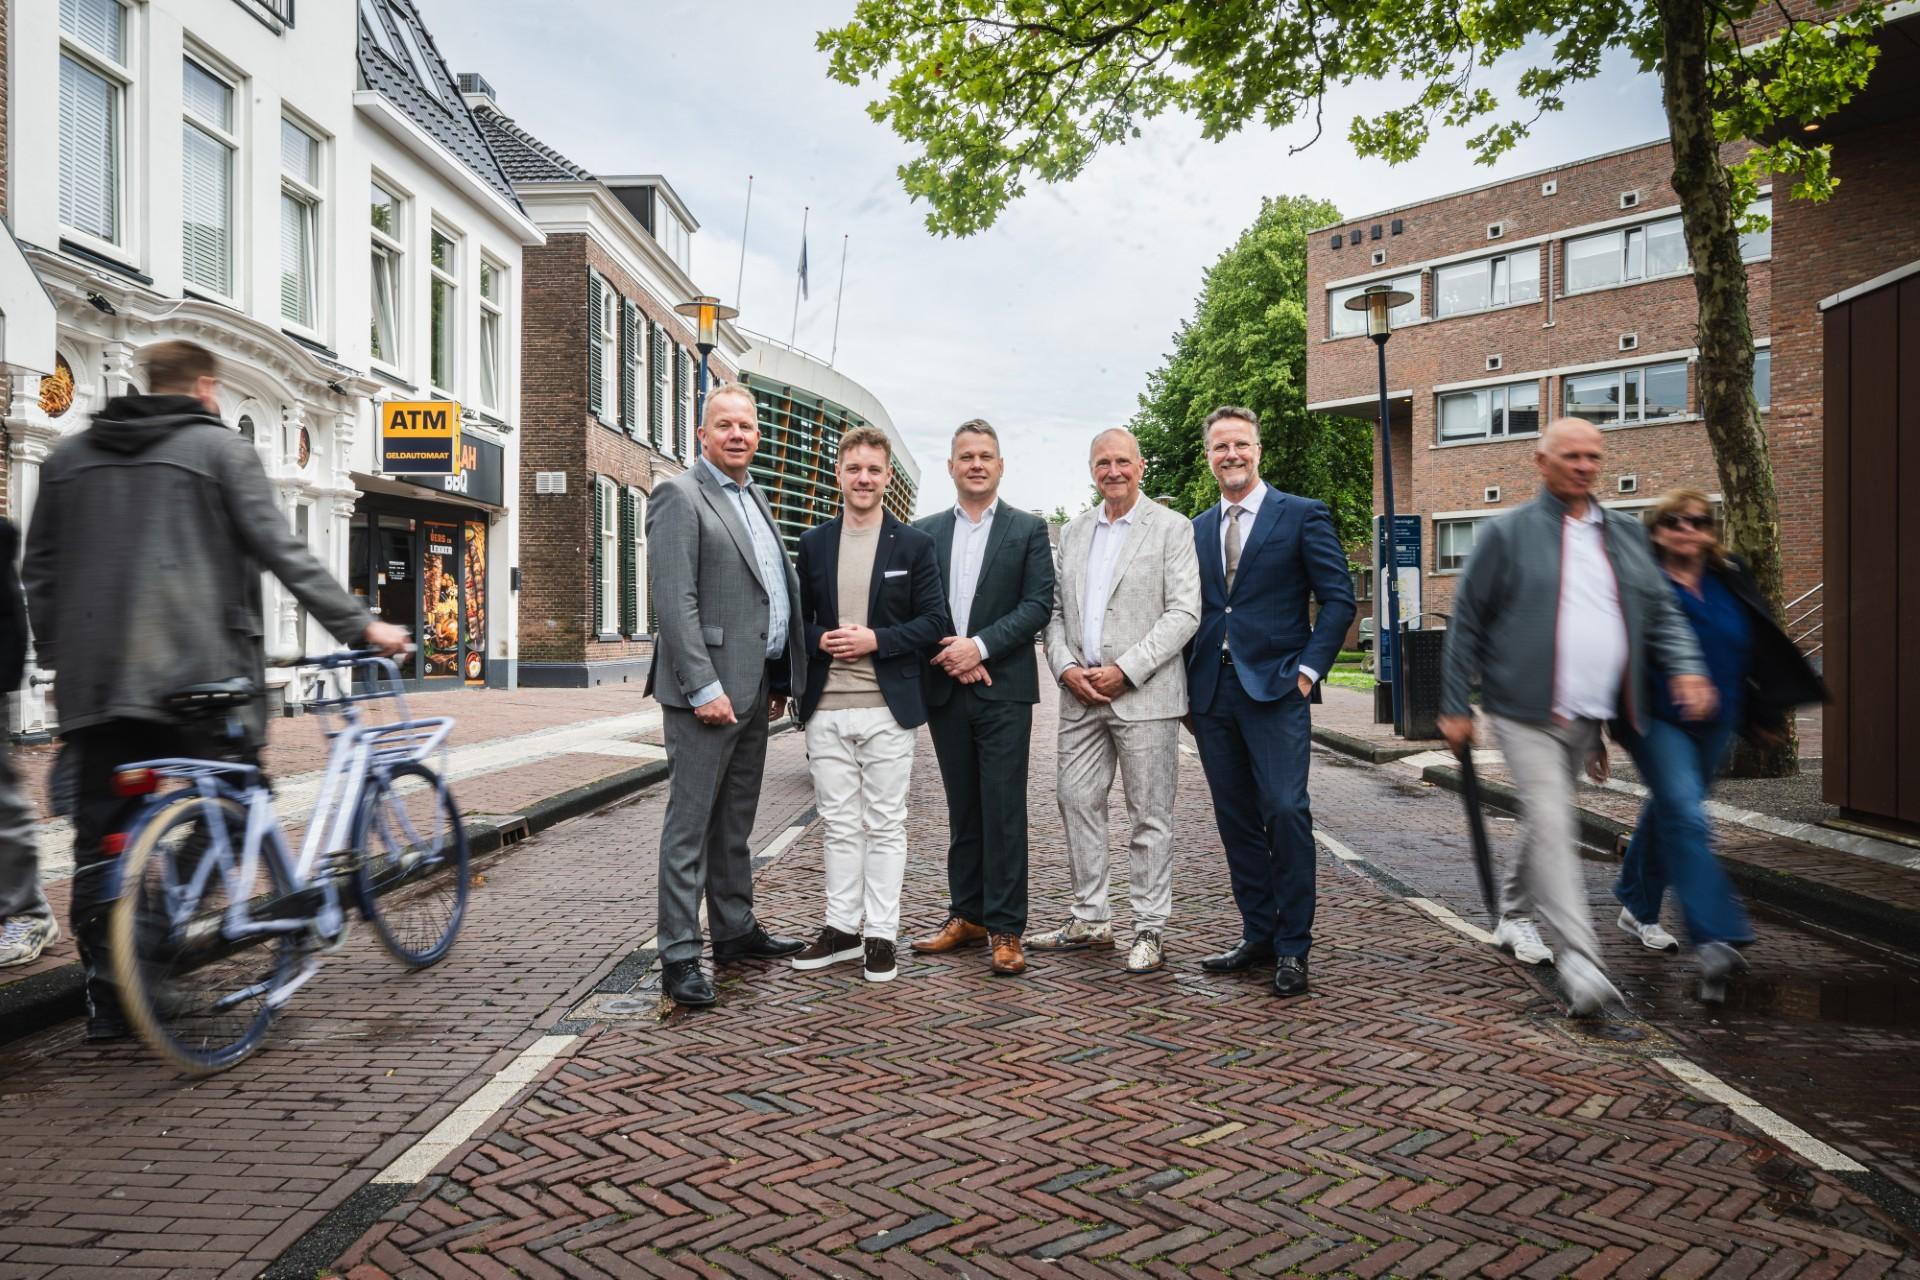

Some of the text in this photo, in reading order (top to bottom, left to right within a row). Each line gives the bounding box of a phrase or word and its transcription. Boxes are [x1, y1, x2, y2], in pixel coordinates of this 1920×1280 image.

[390, 410, 447, 430] ATM
[385, 452, 450, 460] GELDAUTOMAAT
[460, 444, 477, 471] AH
